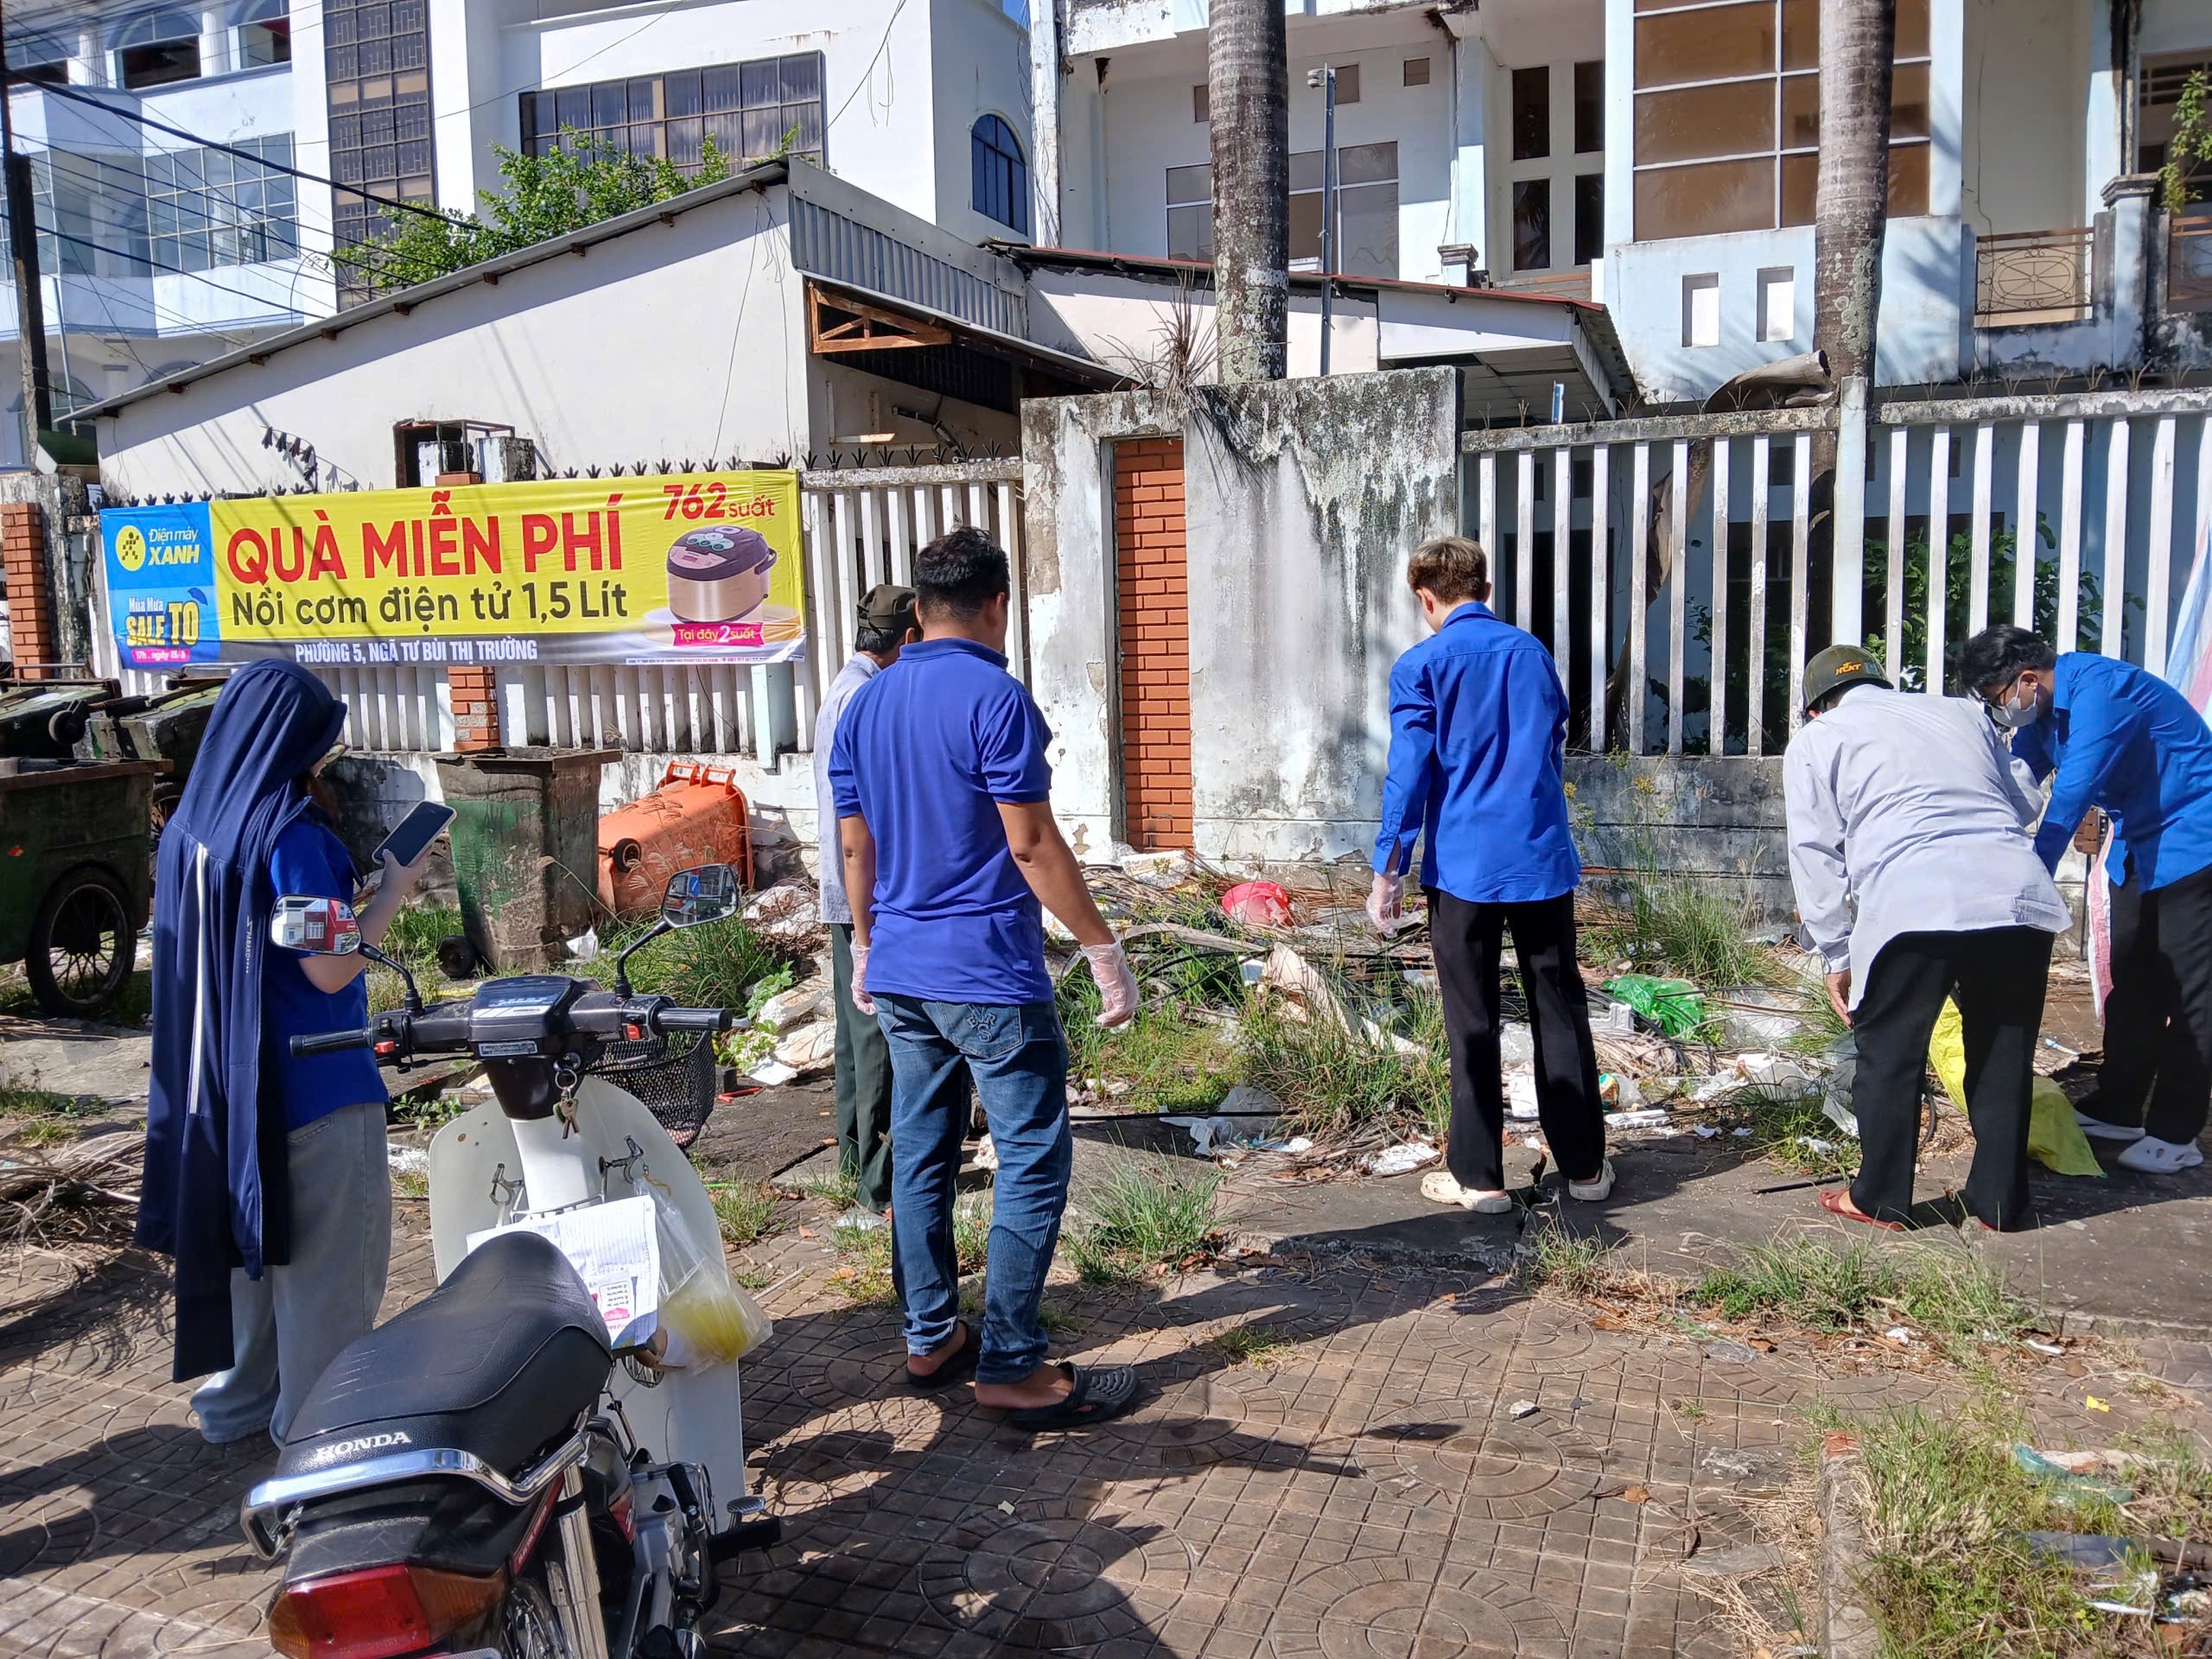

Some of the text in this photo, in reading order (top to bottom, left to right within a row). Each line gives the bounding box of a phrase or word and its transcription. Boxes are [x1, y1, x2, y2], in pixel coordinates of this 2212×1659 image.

[664, 481, 775, 520] 762 suất
[149, 526, 199, 544] Điện máy
[227, 490, 624, 586] QUÀ MIỄN PHÍ
[148, 544, 200, 566] XANH
[232, 580, 628, 632] Nồi cơm điện tử 1,5 Lít
[125, 614, 166, 646] SALE
[677, 629, 695, 644] Tại
[696, 628, 718, 642] đây
[295, 636, 537, 664] PHƯỜNG 5, NGÃ TƯ BÙI THỊ TRƯỜNG
[316, 1432, 412, 1462] HONDA
